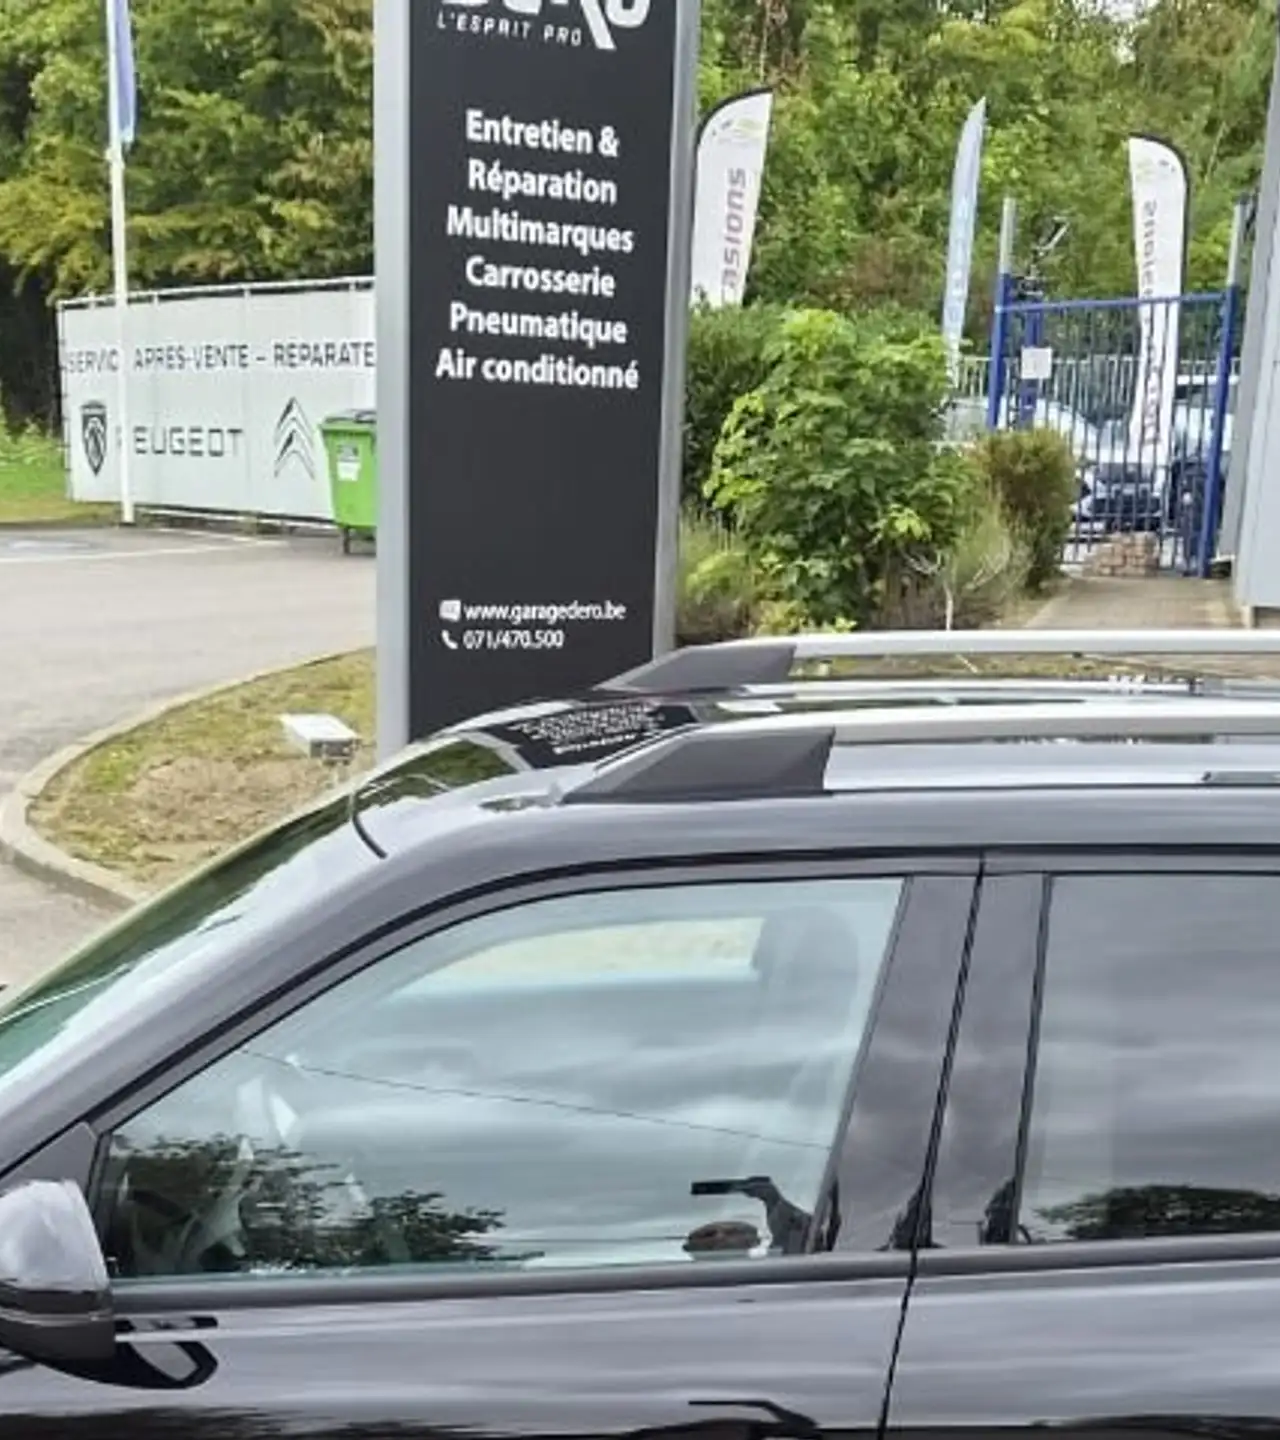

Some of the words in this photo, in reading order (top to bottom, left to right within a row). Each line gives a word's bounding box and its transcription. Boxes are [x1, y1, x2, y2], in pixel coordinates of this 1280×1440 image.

[544, 25, 582, 46] PRO
[466, 108, 593, 154] Entretien
[598, 126, 619, 157] &
[468, 157, 618, 206] Réparation
[446, 204, 634, 256] Multimarques
[465, 255, 616, 297] Carrosserie
[449, 301, 629, 349] Pneumatique
[65, 347, 120, 373] SERVIC
[274, 340, 376, 368] REPARATE
[435, 348, 477, 379] Air
[481, 354, 639, 389] conditionné
[116, 426, 244, 457] EUGEOT
[463, 600, 627, 626] www.garagedero.be
